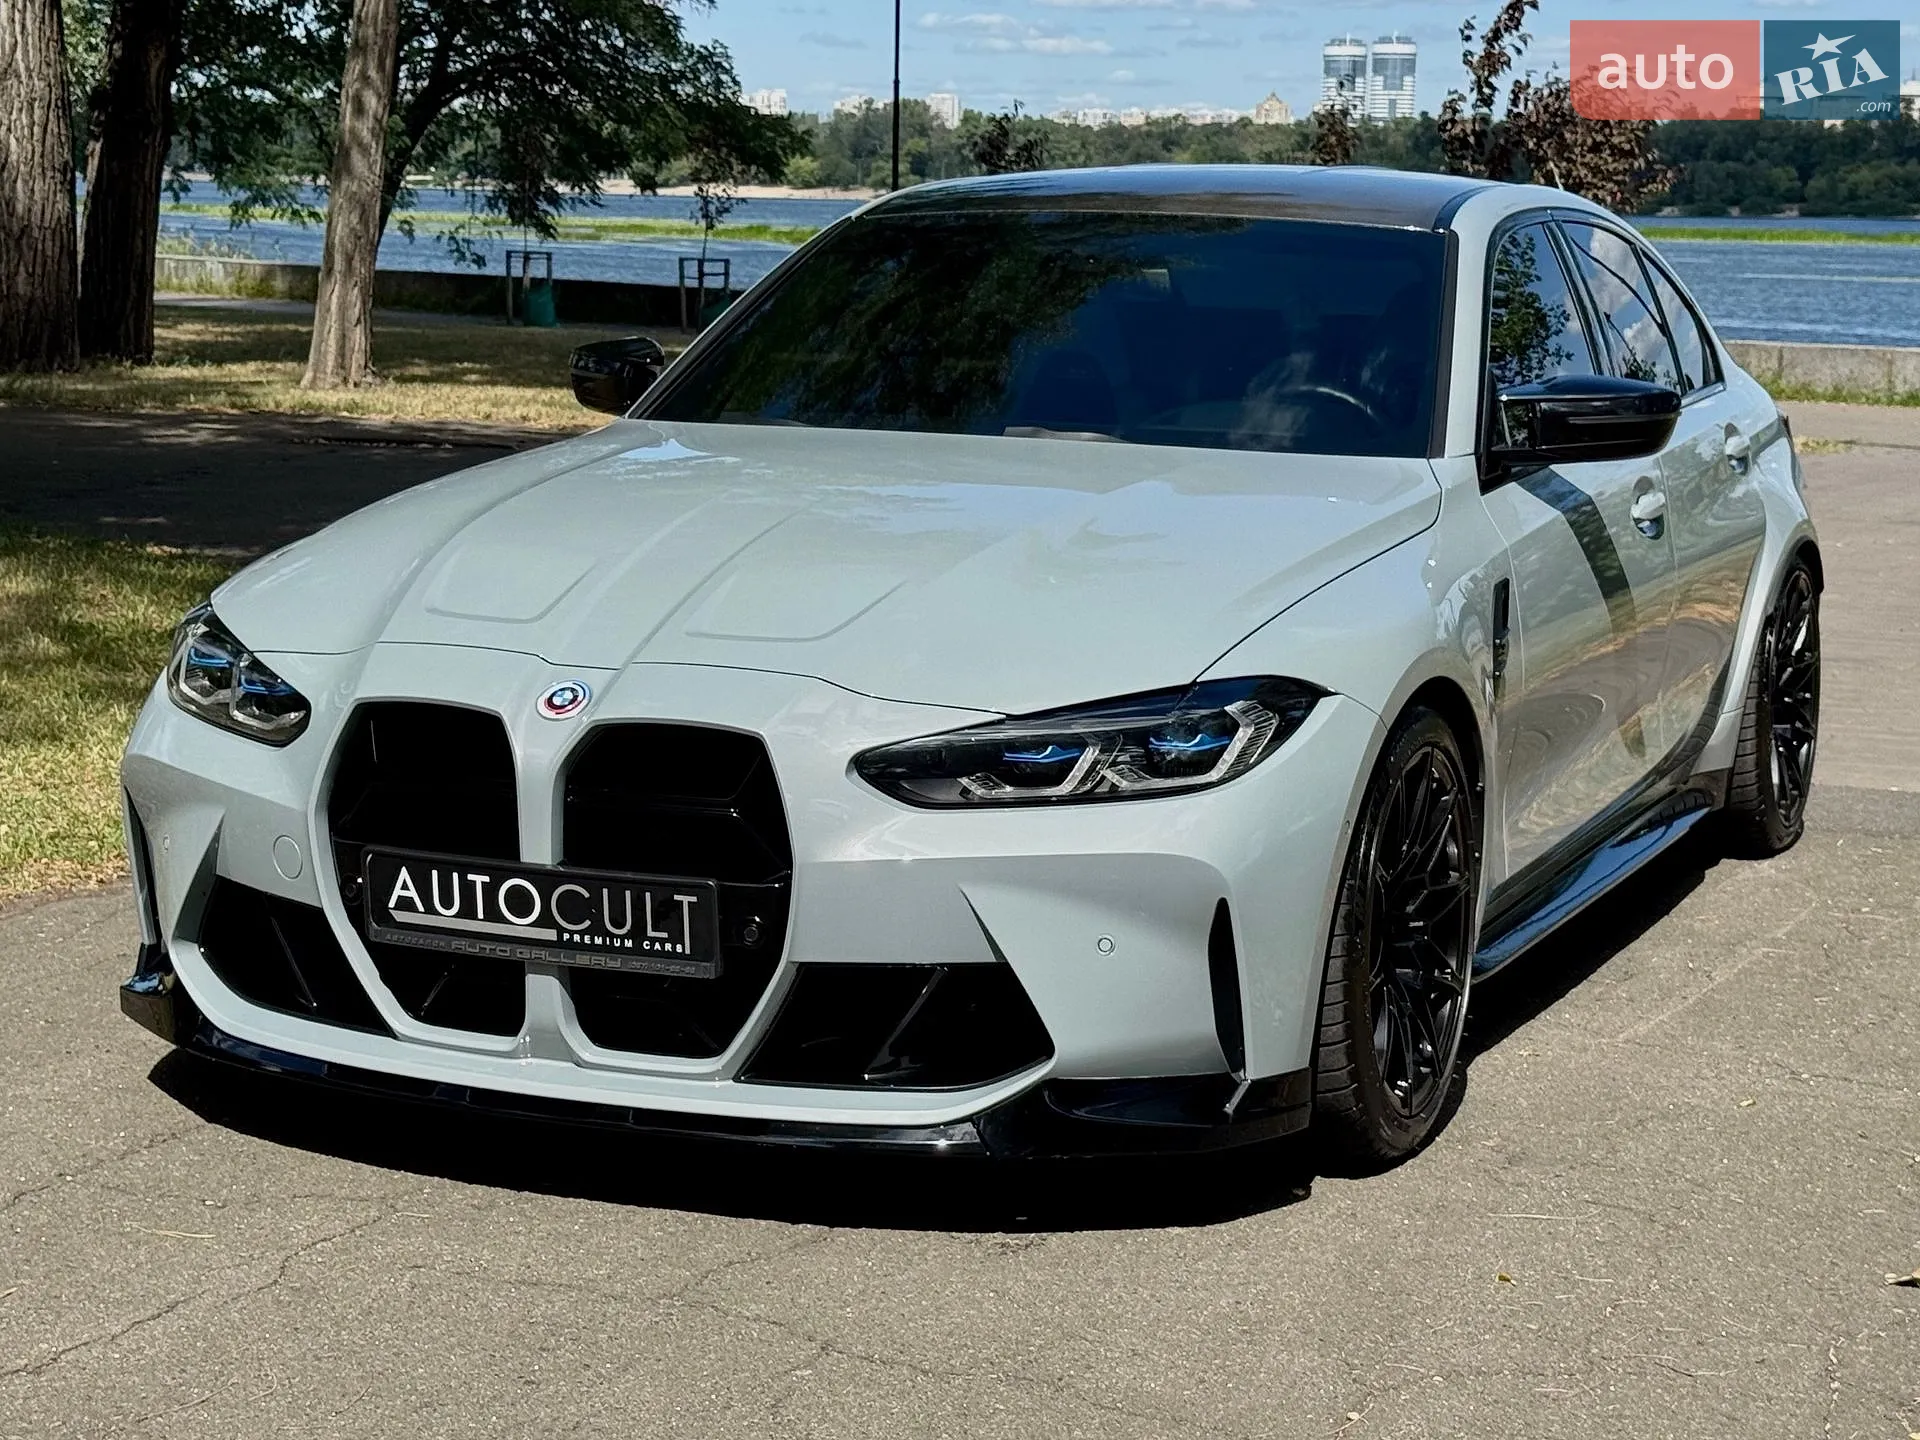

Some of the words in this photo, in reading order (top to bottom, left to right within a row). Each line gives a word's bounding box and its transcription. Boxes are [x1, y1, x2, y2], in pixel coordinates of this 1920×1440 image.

[388, 865, 698, 955] AUTOCULT
[450, 940, 511, 958] AUTO
[515, 948, 623, 968] GALLERY
[562, 932, 633, 948] PREMIUM
[642, 940, 683, 953] CARS
